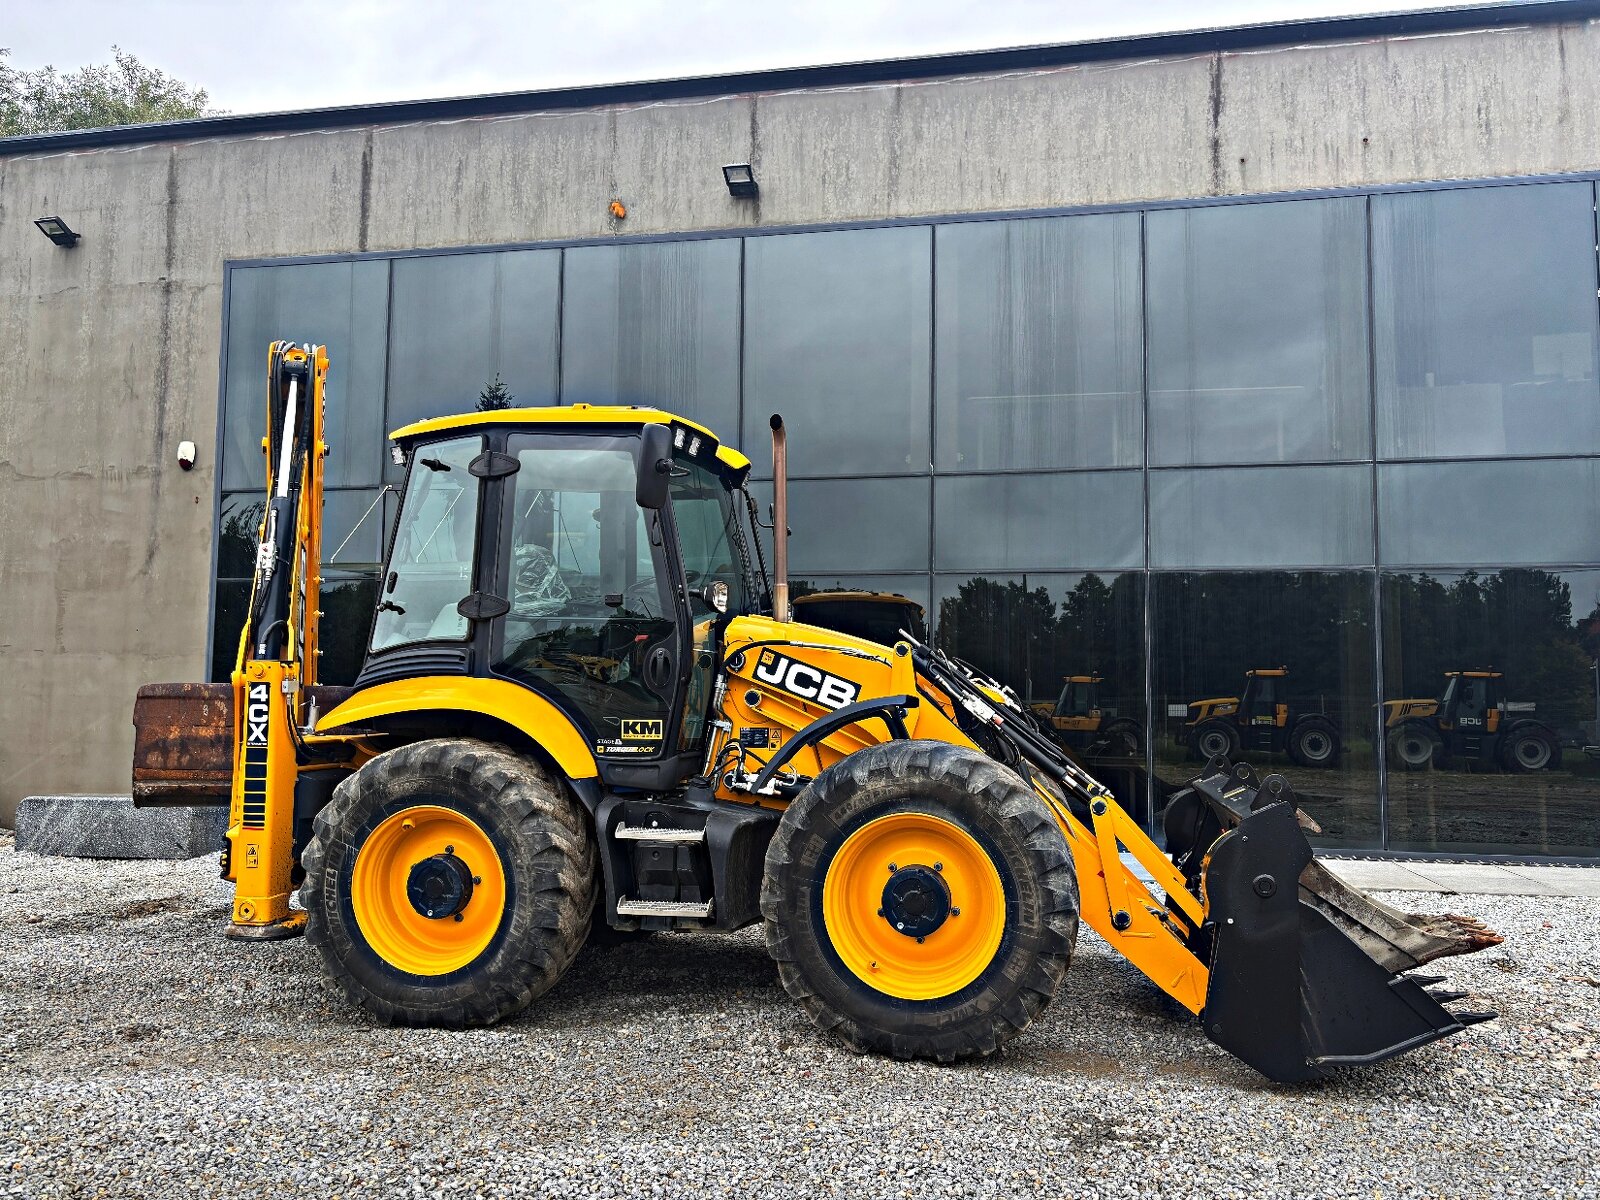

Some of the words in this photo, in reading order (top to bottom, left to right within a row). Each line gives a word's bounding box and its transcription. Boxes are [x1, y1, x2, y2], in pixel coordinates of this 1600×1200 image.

[757, 657, 856, 709] JCB
[247, 684, 269, 742] 4CX
[623, 721, 661, 734] KM
